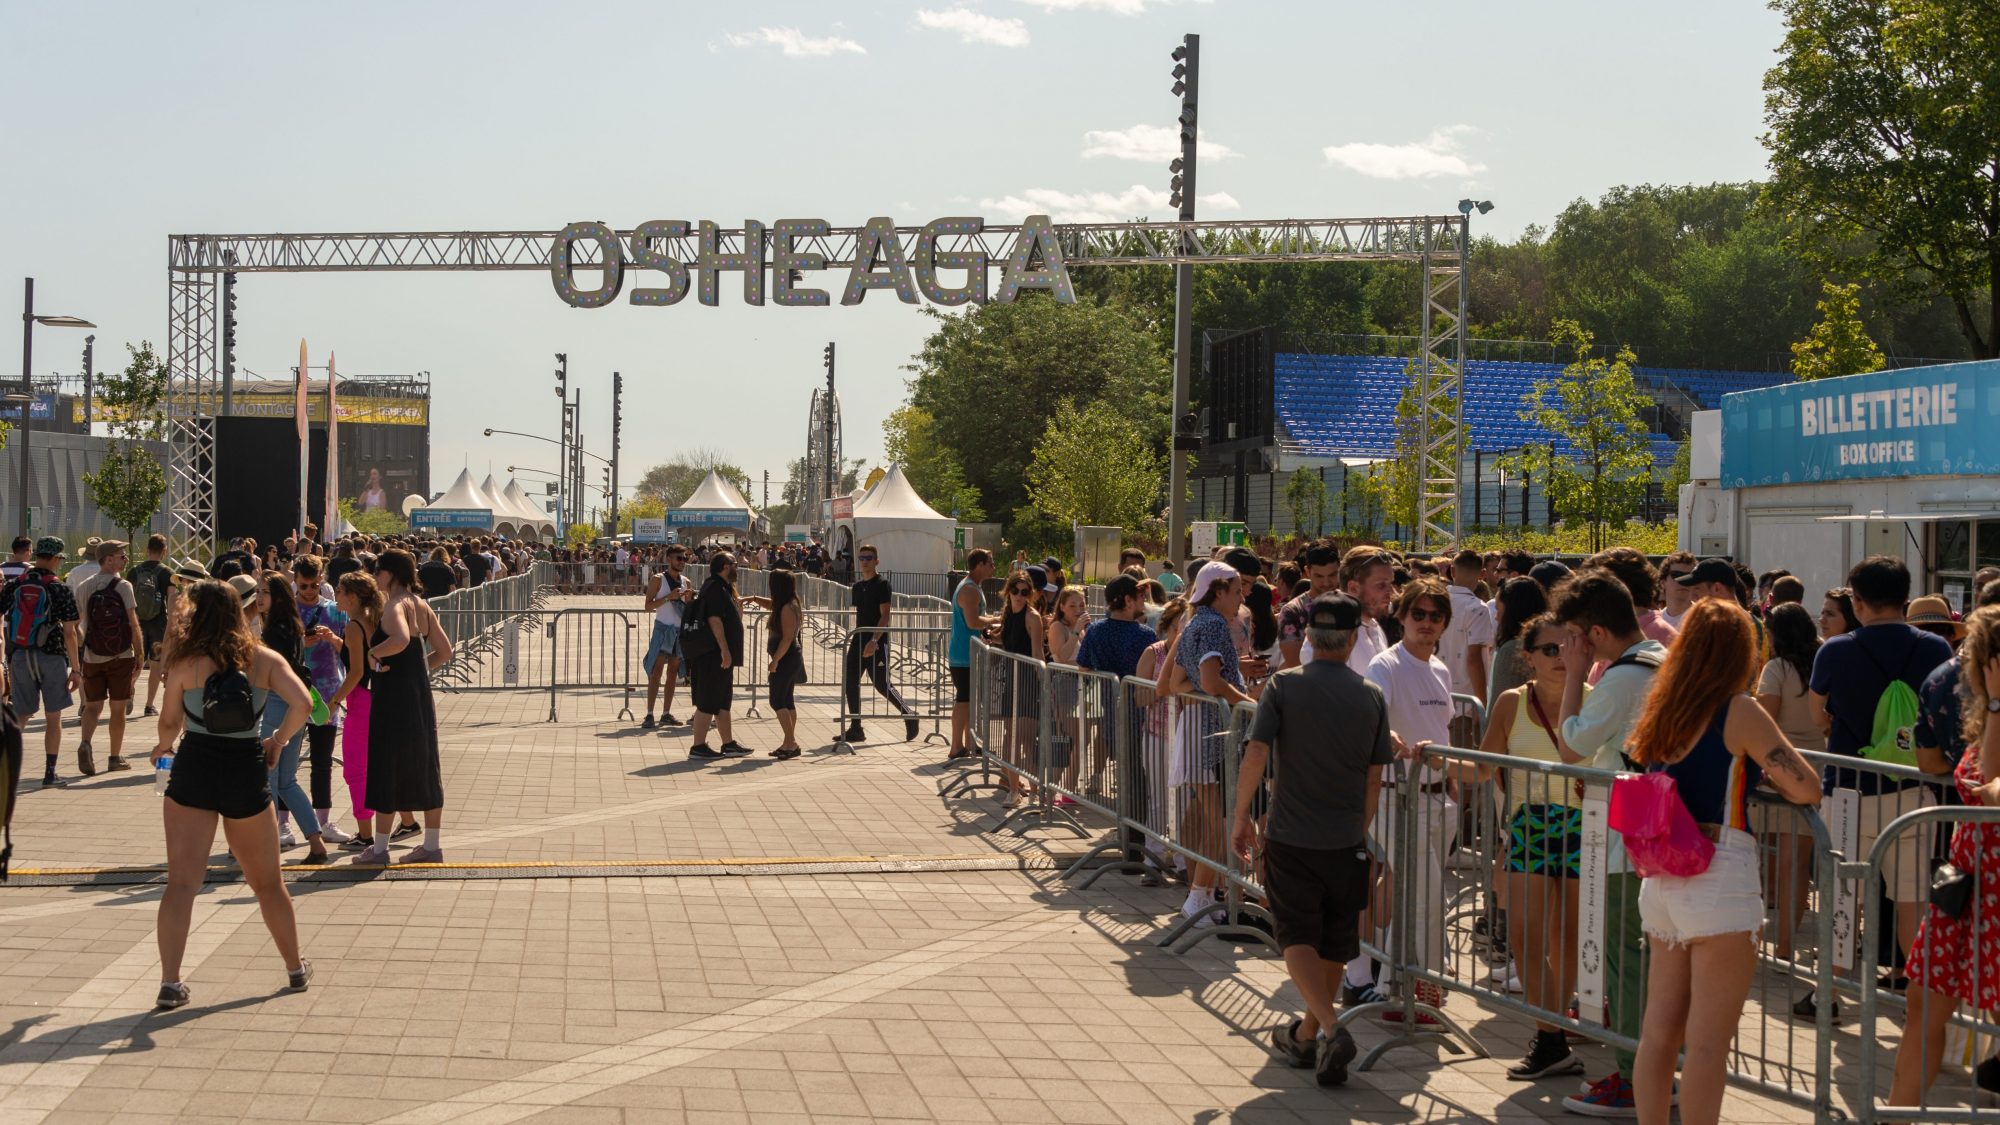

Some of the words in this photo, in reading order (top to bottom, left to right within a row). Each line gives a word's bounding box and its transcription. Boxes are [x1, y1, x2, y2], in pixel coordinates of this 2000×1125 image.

[550, 214, 1078, 308] OSHEAGA
[232, 402, 316, 416] MONTAGE
[1801, 382, 1958, 437] BILLETTERIE
[1840, 442, 1867, 466] BOX
[1869, 439, 1915, 463] OFFICE
[416, 513, 451, 523] ENTRÉE
[671, 513, 706, 522] ENTRÉE
